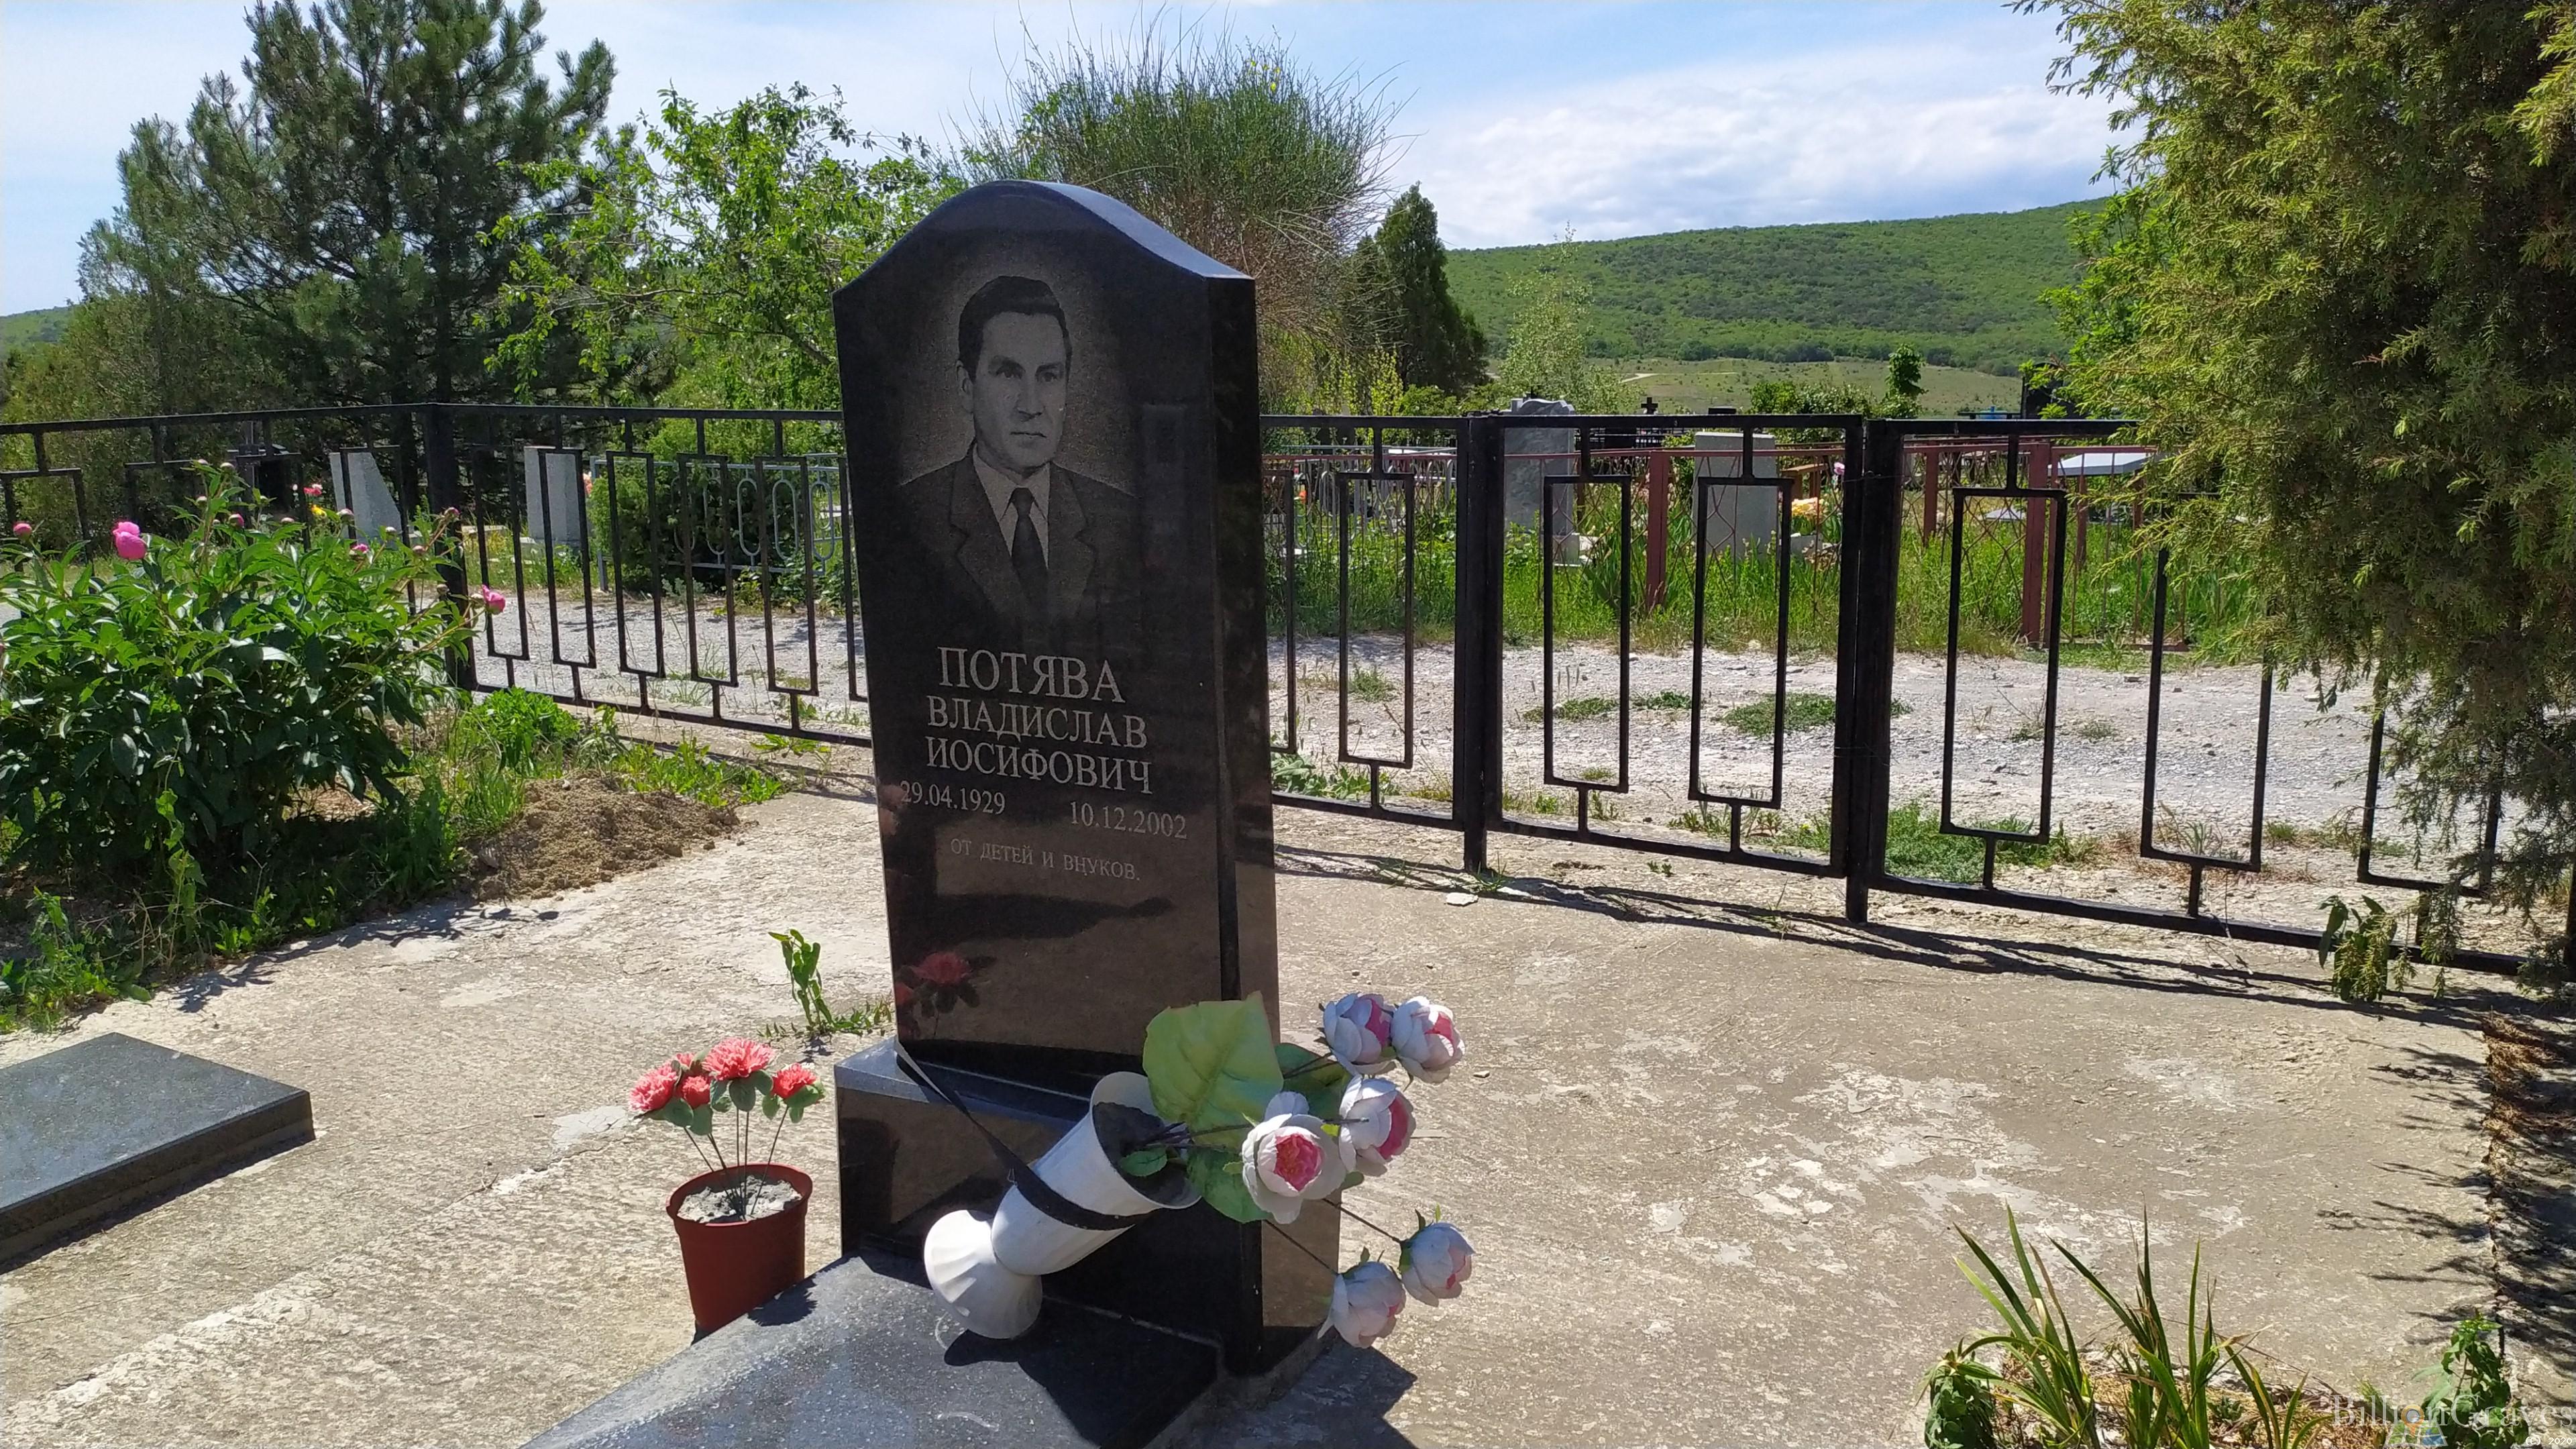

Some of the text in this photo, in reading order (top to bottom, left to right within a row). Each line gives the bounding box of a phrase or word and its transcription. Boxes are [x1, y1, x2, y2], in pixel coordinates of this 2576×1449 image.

[937, 646, 1126, 703] ПОТЯВА
[926, 695, 1148, 749] ВЛАДИСЛАВ
[925, 736, 1152, 794] ИОСИФОВИЧ
[900, 780, 1187, 839] 29.04.1929 10.12.2002
[950, 838, 1140, 881] ОТ ДЕТЕЙ И ВНУКОВ.
